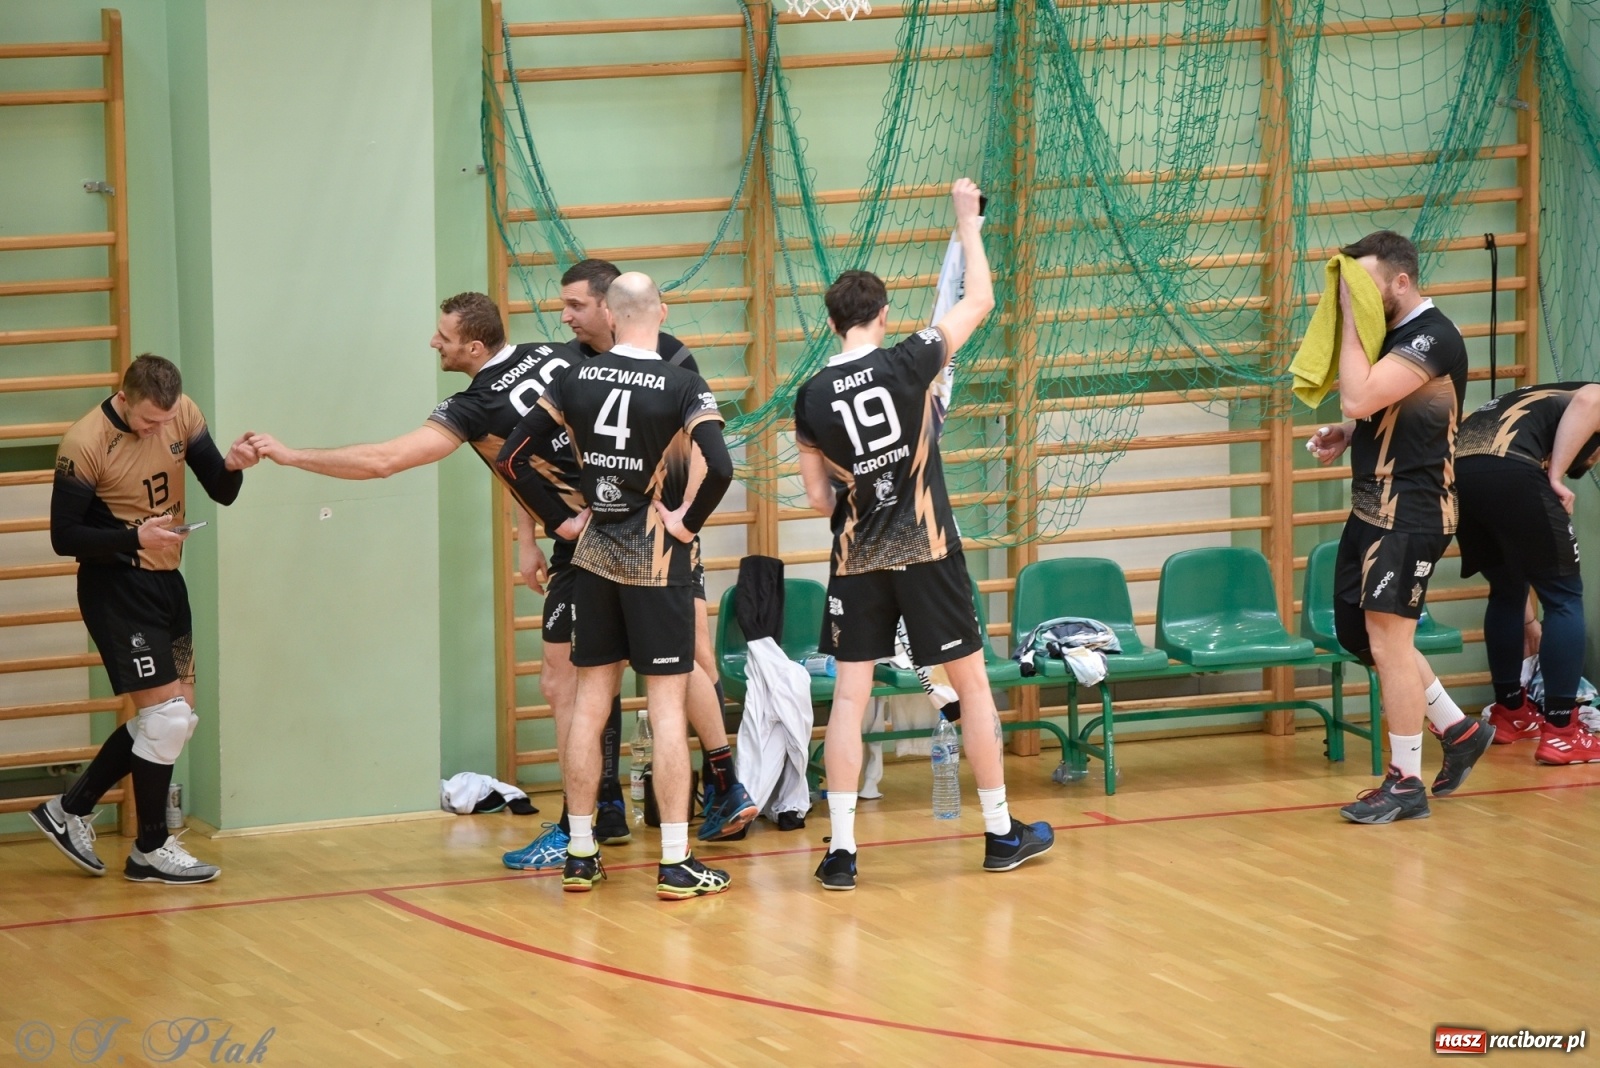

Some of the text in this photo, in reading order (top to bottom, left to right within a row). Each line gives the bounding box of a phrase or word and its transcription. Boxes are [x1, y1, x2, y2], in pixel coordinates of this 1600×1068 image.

[535, 345, 554, 357] W
[578, 366, 666, 391] KOCZWARA
[832, 367, 875, 394] BART
[593, 387, 632, 451] 4
[830, 386, 902, 457] 19
[582, 451, 644, 472] AGROTIM
[852, 444, 911, 476] AGROTIM
[142, 471, 169, 510] 13
[132, 656, 157, 678] 13
[652, 656, 680, 665] AGROTIM
